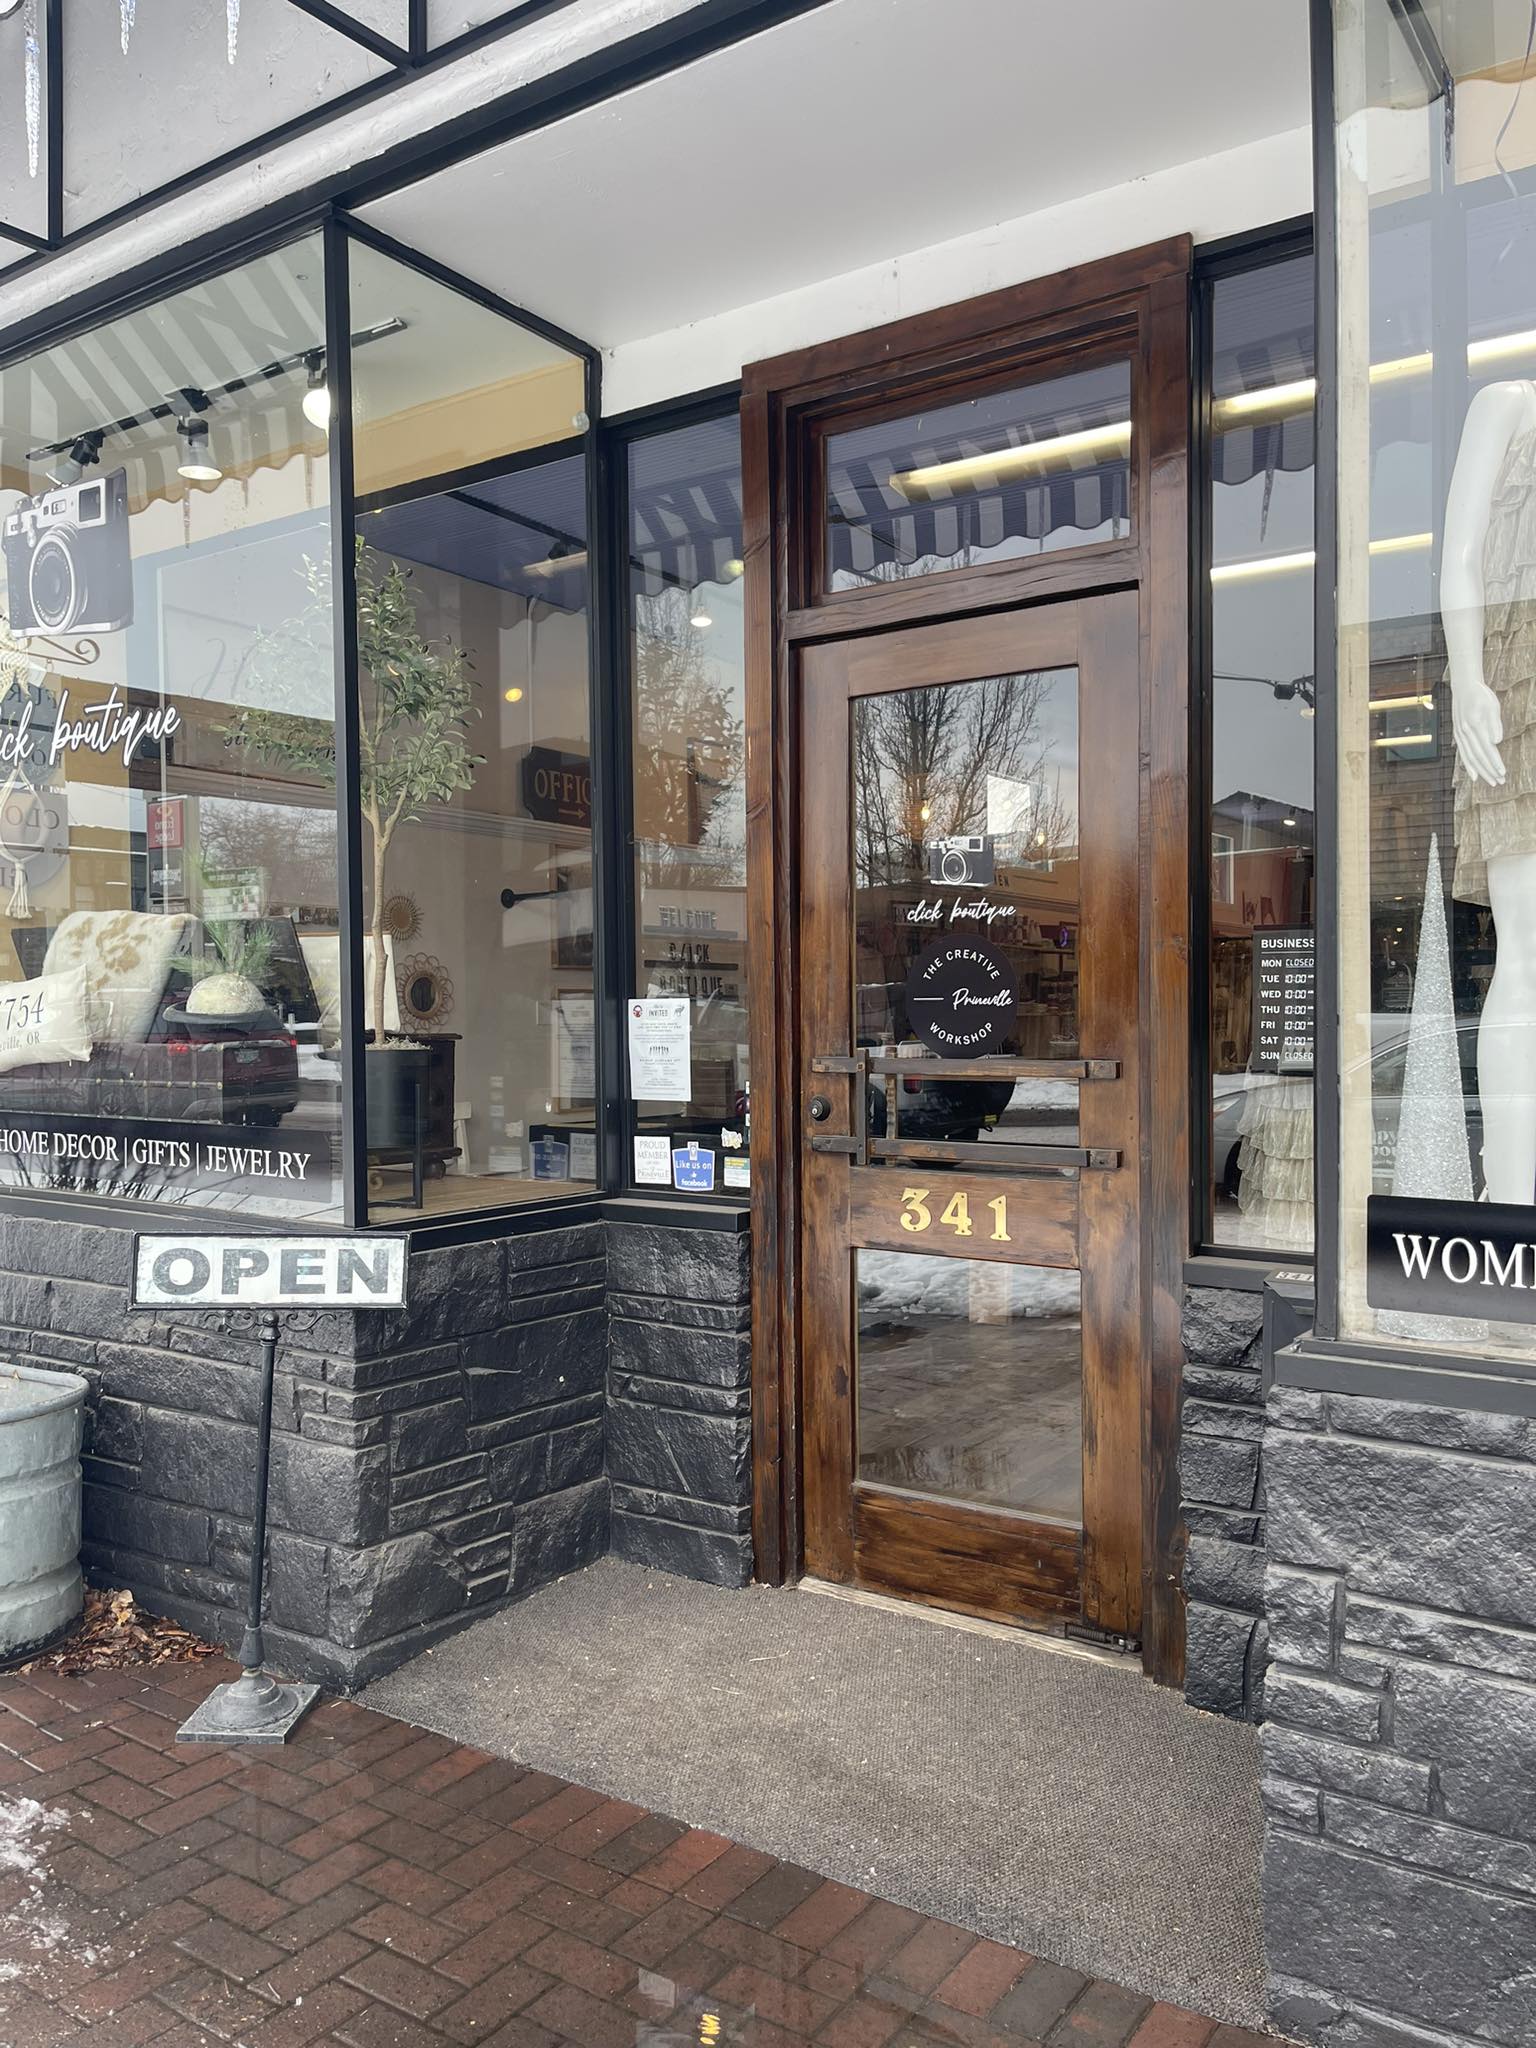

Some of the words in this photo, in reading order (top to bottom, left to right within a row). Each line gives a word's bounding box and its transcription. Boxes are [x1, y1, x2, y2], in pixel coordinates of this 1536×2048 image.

[49, 686, 182, 768] boutique
[907, 898, 944, 922] click
[949, 896, 1017, 925] boutique
[1260, 938, 1315, 949] BUSINESS
[922, 957, 944, 981] THE
[945, 948, 1001, 981] CREATIVE
[1261, 959, 1282, 968] MON
[1261, 974, 1280, 983] TUE
[951, 987, 1014, 1011] Prineville
[1260, 990, 1281, 998] WED
[0, 991, 44, 1031] 754
[1260, 1005, 1280, 1014] THU
[1260, 1021, 1276, 1029] FRI
[26, 1031, 40, 1046] OR
[929, 1021, 993, 1046] WORKSHOP
[1260, 1036, 1279, 1045] SAT
[1260, 1051, 1280, 1060] SUN
[639, 1140, 666, 1150] PROUD
[0, 1129, 49, 1155] HOME
[53, 1132, 120, 1162] DECOR
[132, 1138, 191, 1168] GIFTS
[205, 1145, 312, 1181] JEWELRY
[637, 1150, 668, 1160] MEMBER
[675, 1160, 690, 1169] Like
[692, 1161, 701, 1169] us
[702, 1162, 712, 1170] on
[681, 1178, 708, 1187] facebook
[899, 1187, 1012, 1241] 341
[1391, 1232, 1536, 1289] WOM
[151, 1246, 390, 1297] OPEN
